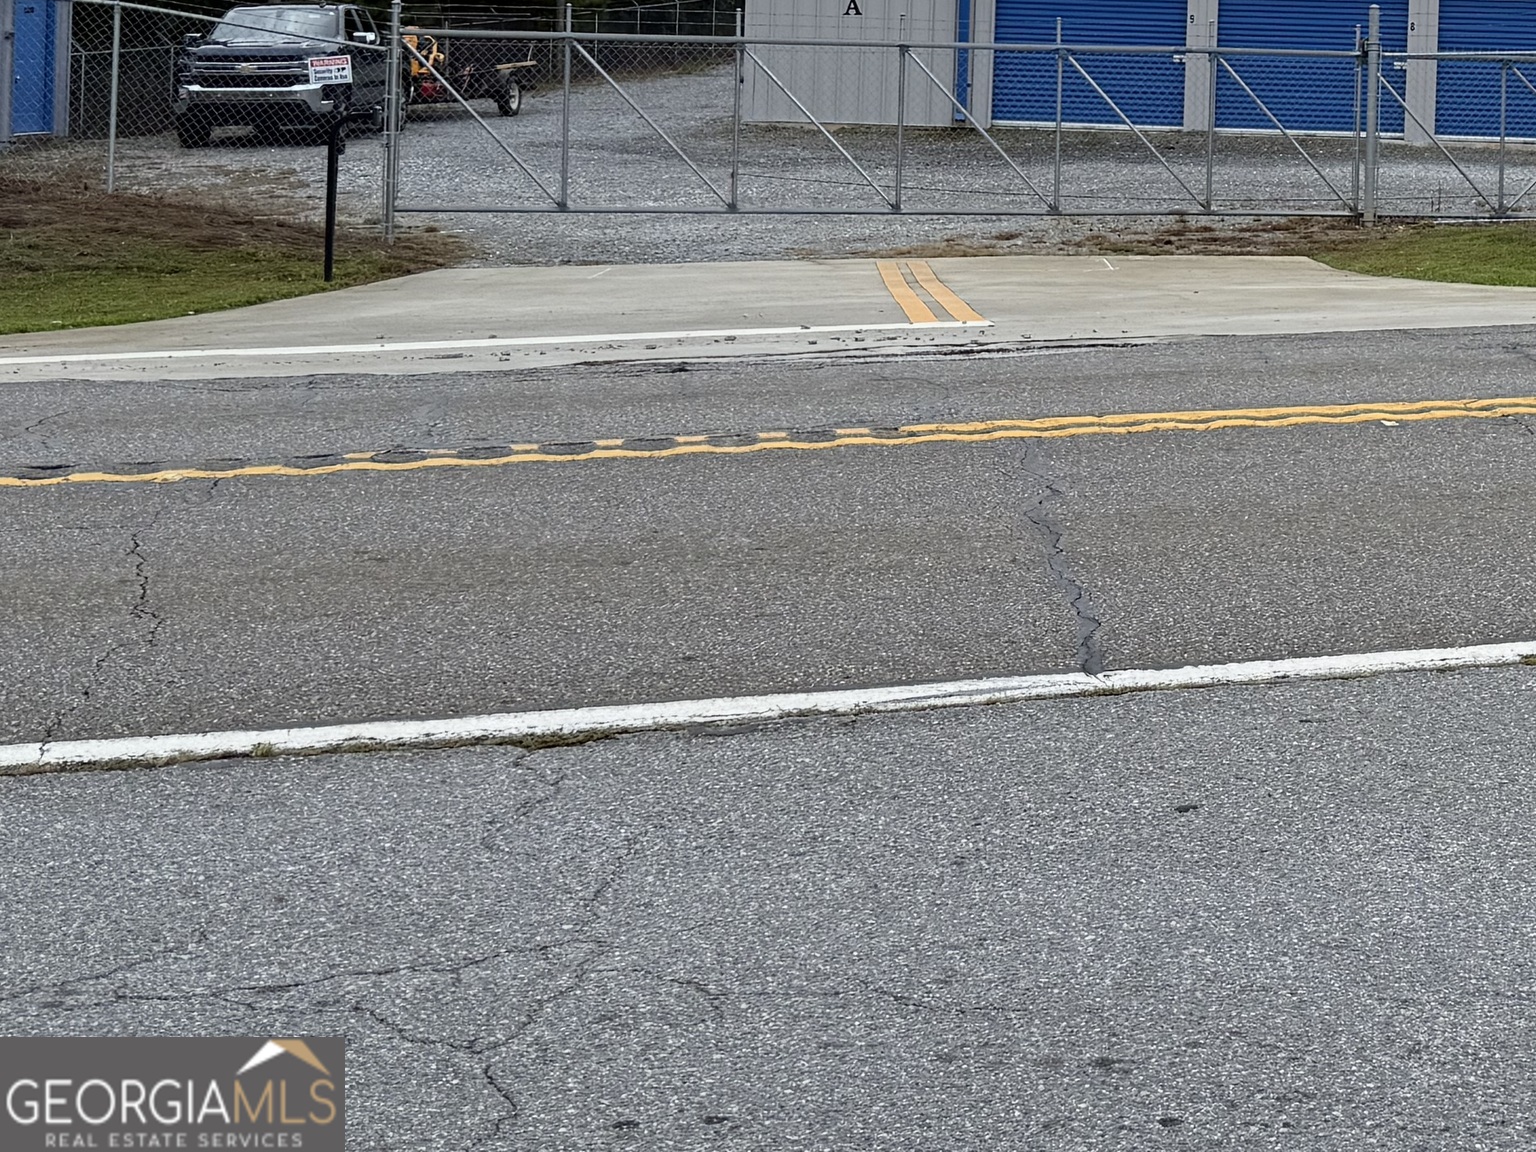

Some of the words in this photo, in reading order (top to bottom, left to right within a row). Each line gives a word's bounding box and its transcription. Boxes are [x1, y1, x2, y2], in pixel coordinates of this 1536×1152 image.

[1189, 14, 1195, 24] 9
[1410, 22, 1416, 31] 8
[311, 57, 348, 67] WARNING
